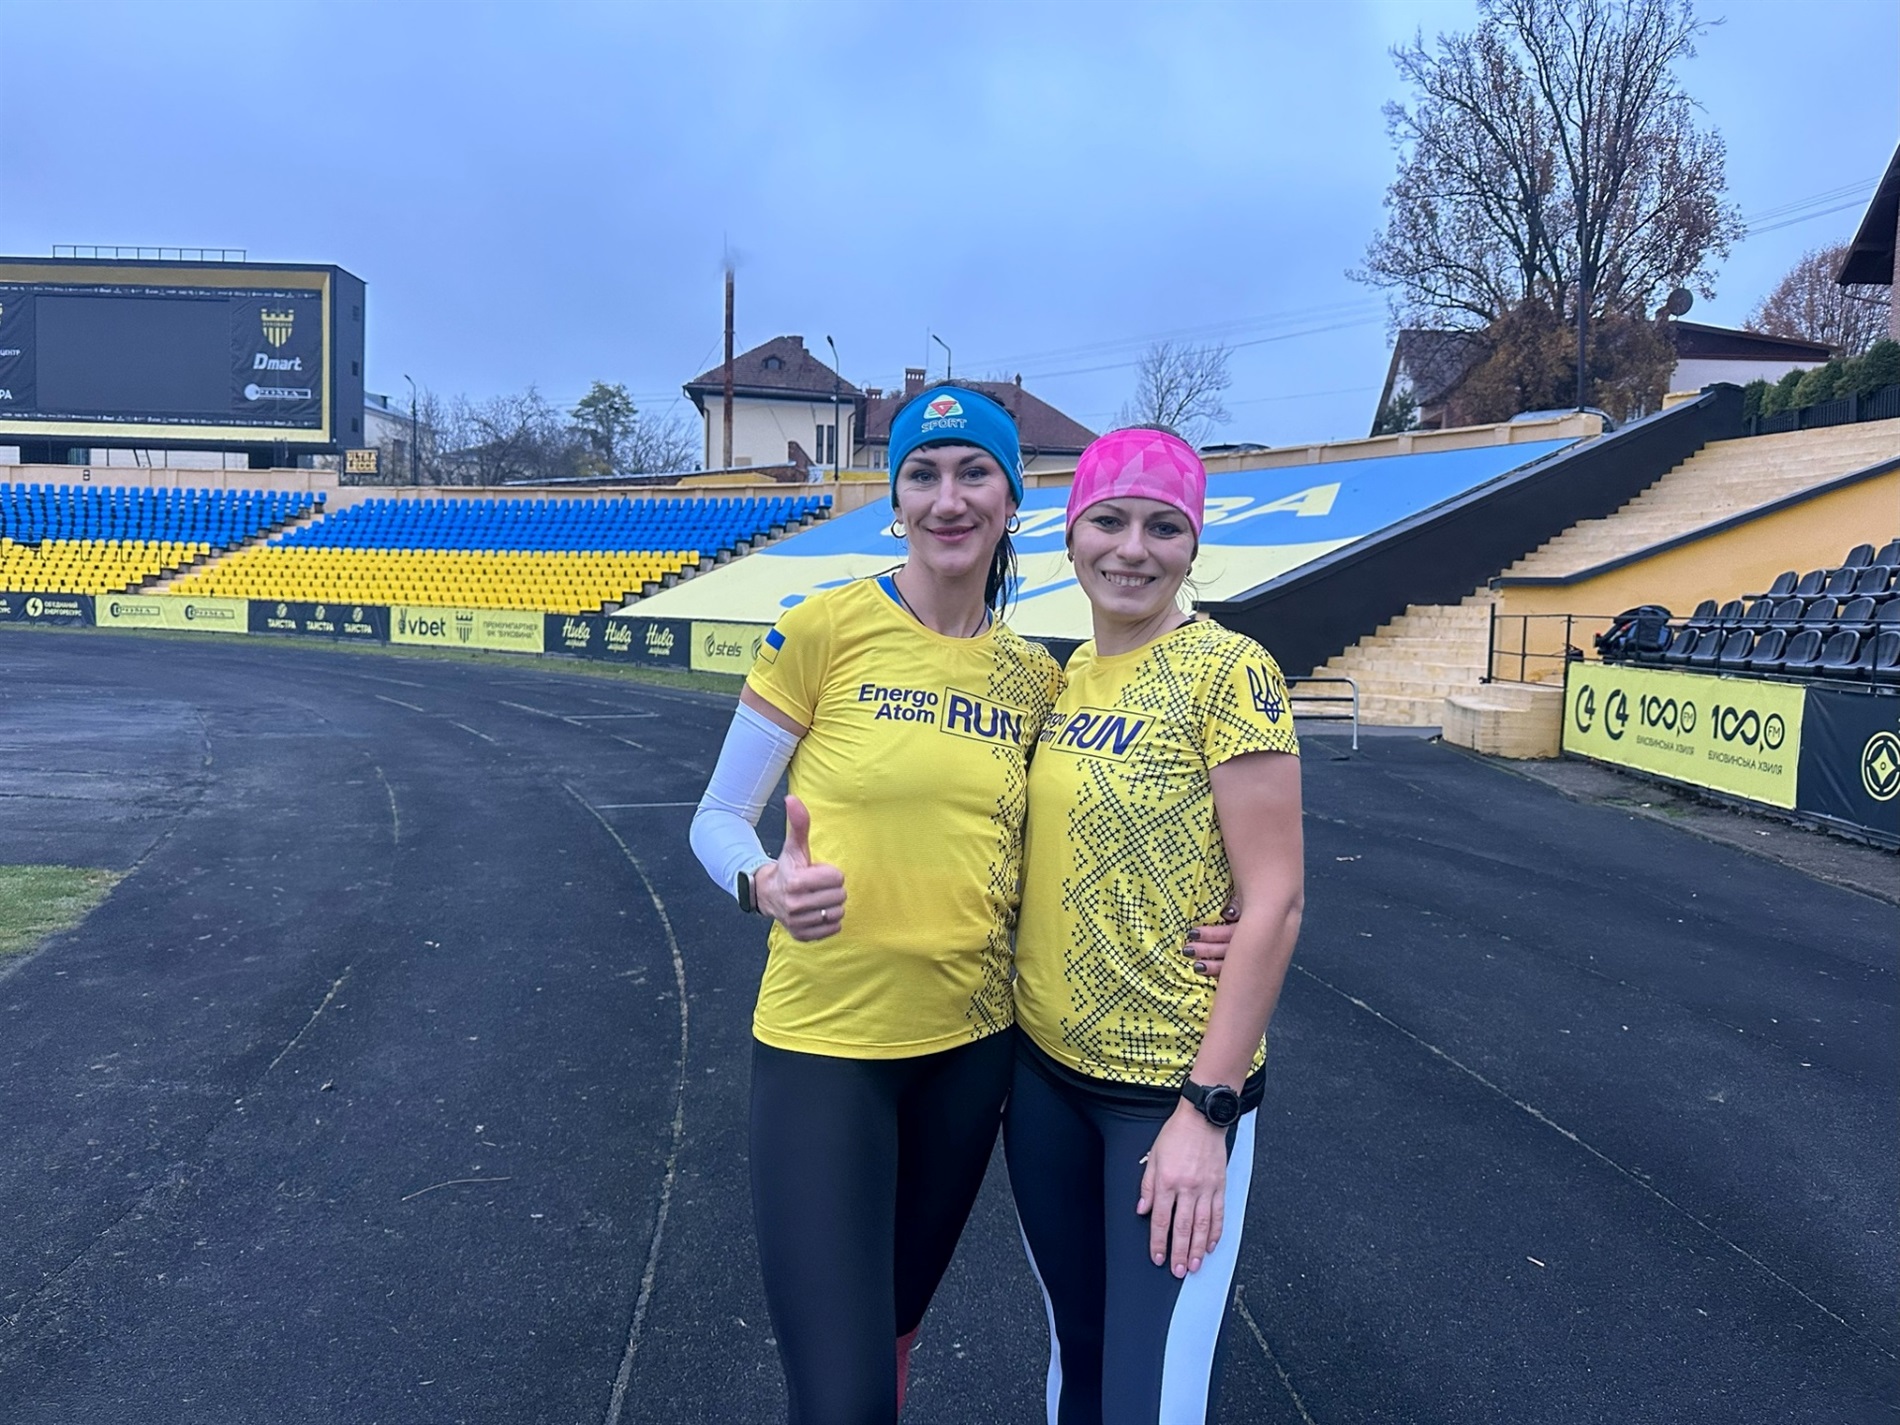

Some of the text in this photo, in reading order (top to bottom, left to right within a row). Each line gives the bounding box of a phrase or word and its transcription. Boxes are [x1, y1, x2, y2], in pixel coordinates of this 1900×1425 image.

[253, 353, 302, 371] Dmart
[921, 418, 968, 433] SPORT
[408, 616, 446, 637] vbet
[715, 643, 743, 658] stels
[858, 683, 939, 707] Energo
[874, 703, 935, 724] Atom
[946, 694, 1024, 744] RUN
[1057, 713, 1146, 755] RUN
[1758, 762, 1783, 776] ХВИЛЯ
